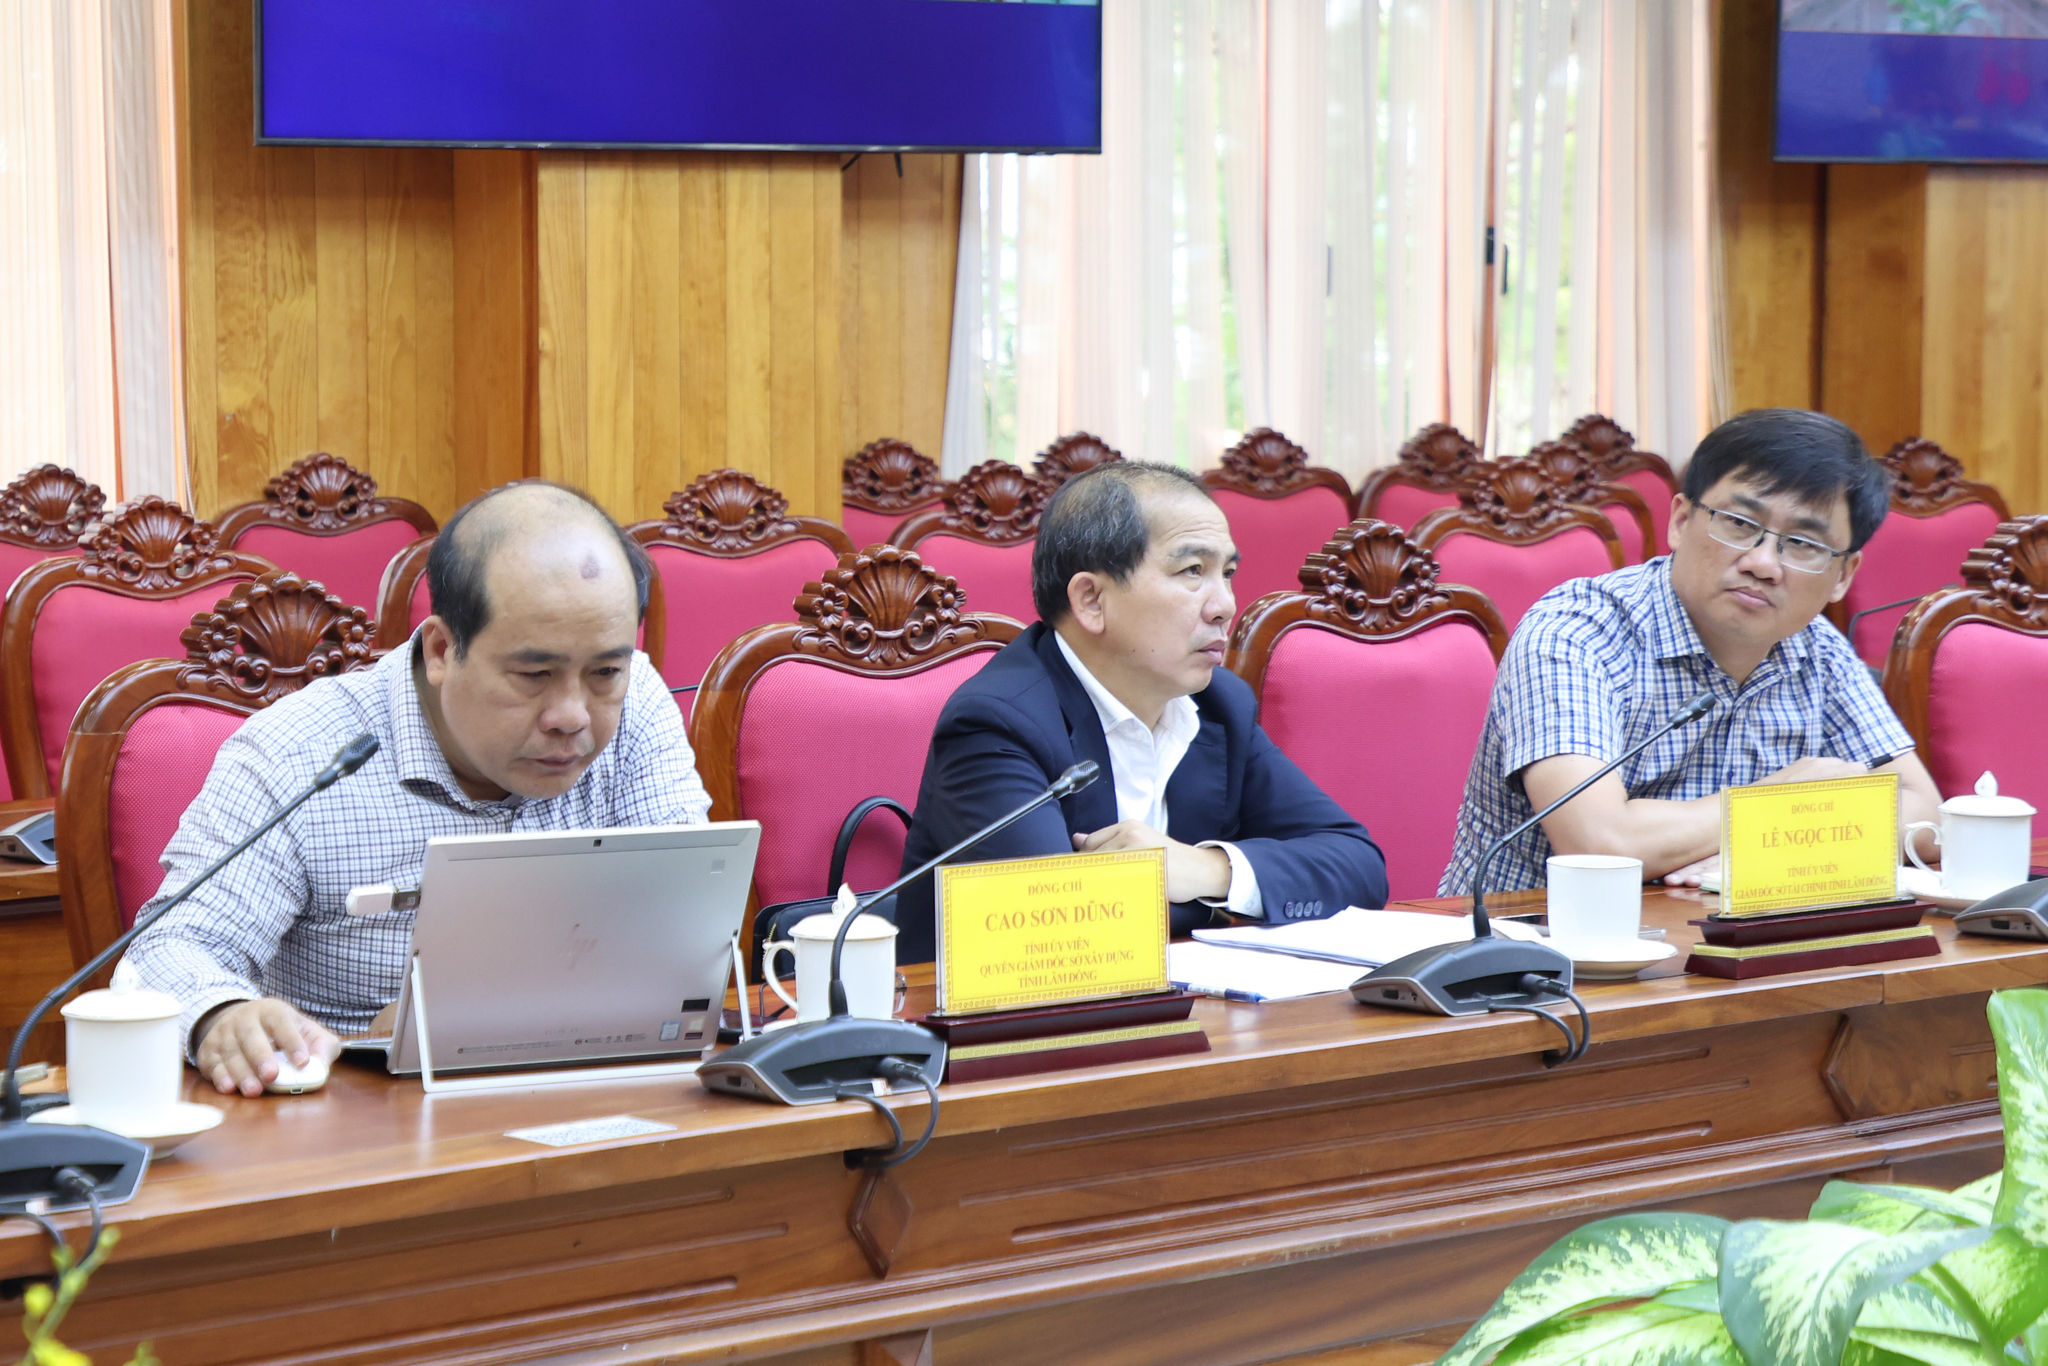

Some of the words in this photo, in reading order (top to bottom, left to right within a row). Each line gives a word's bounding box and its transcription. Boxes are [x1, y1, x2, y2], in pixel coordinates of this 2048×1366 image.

[1762, 826, 1780, 848] LÊ
[1783, 826, 1826, 848] NGỌC
[985, 911, 1026, 932] CAO
[1030, 906, 1068, 928] SƠN
[1074, 900, 1124, 924] DŨNG
[1066, 936, 1090, 951] VIÊN
